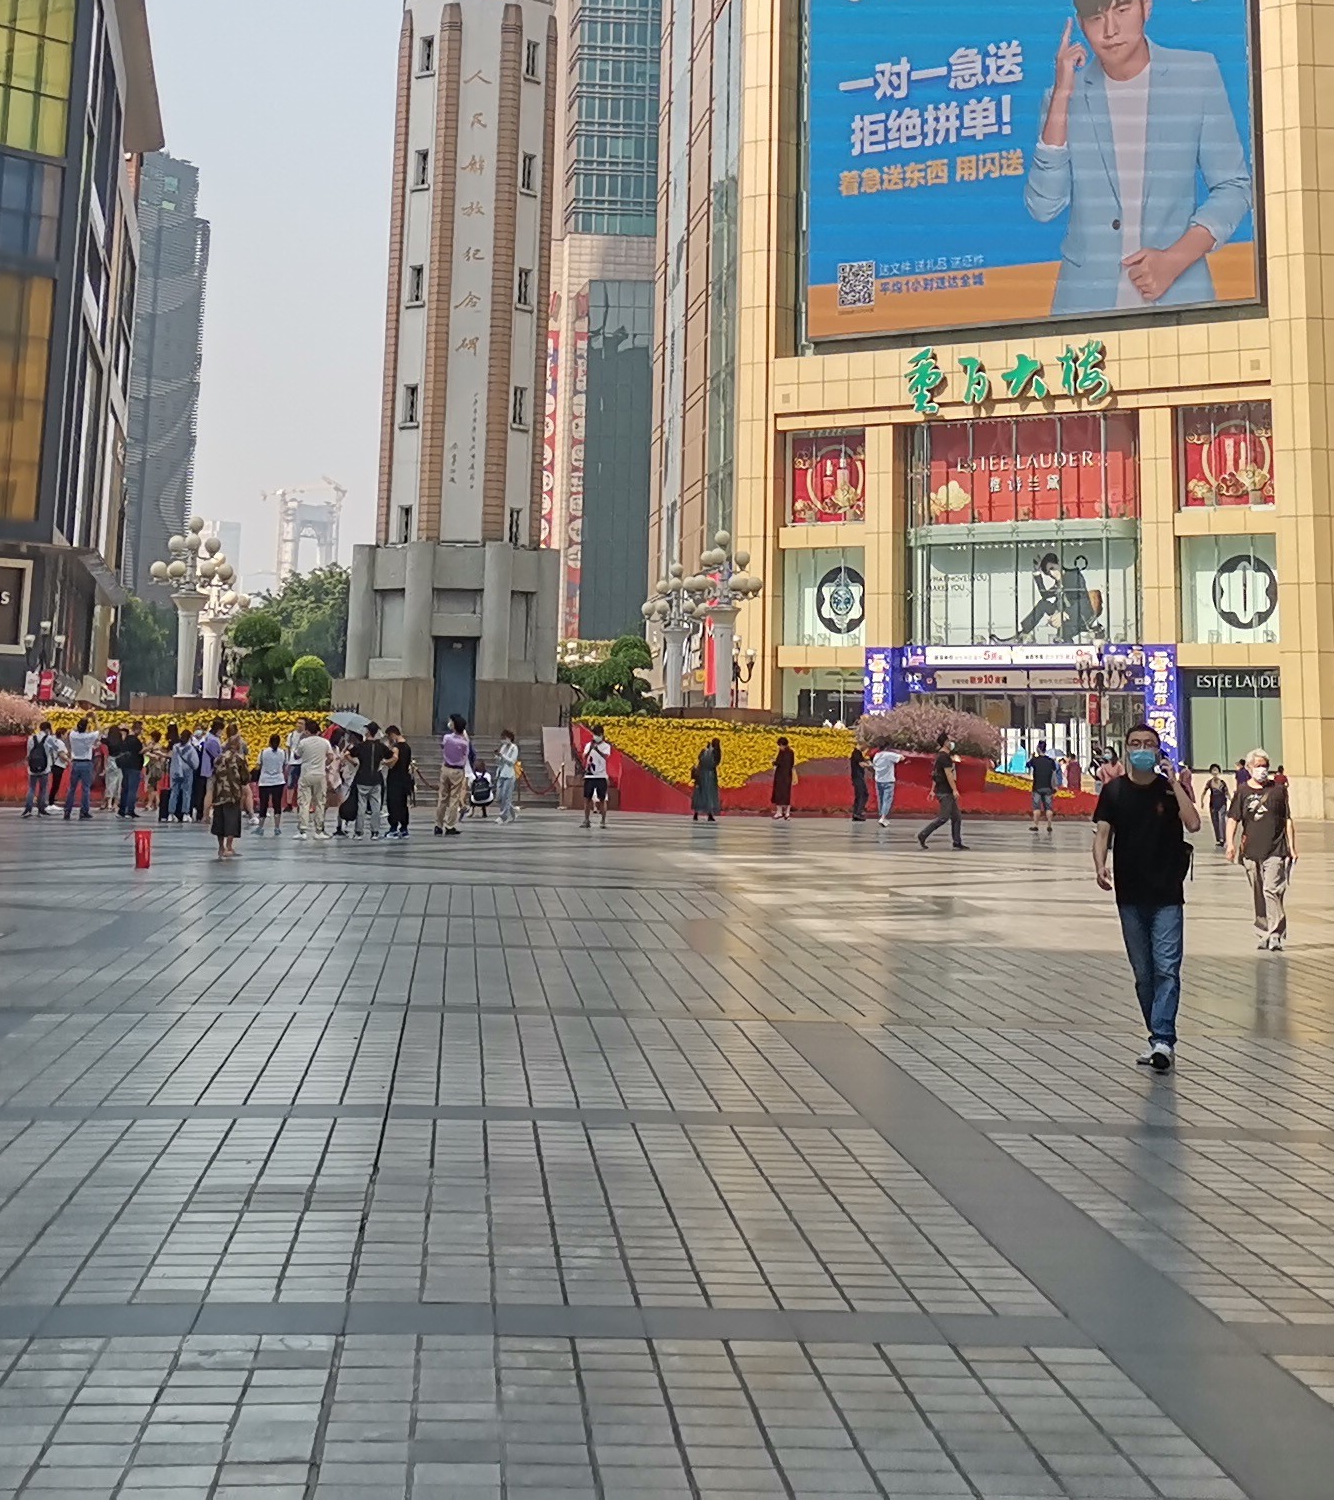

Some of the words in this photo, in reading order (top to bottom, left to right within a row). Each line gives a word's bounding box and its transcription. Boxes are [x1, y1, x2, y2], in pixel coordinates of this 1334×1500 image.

[839, 40, 1023, 100] 一对一急送
[850, 95, 1012, 156] 拒绝拼单!
[838, 159, 948, 196] 着急送东西
[955, 150, 1025, 182] 用闪送
[990, 474, 1060, 492] 雅诗兰黛
[1016, 450, 1094, 471] LAUDER
